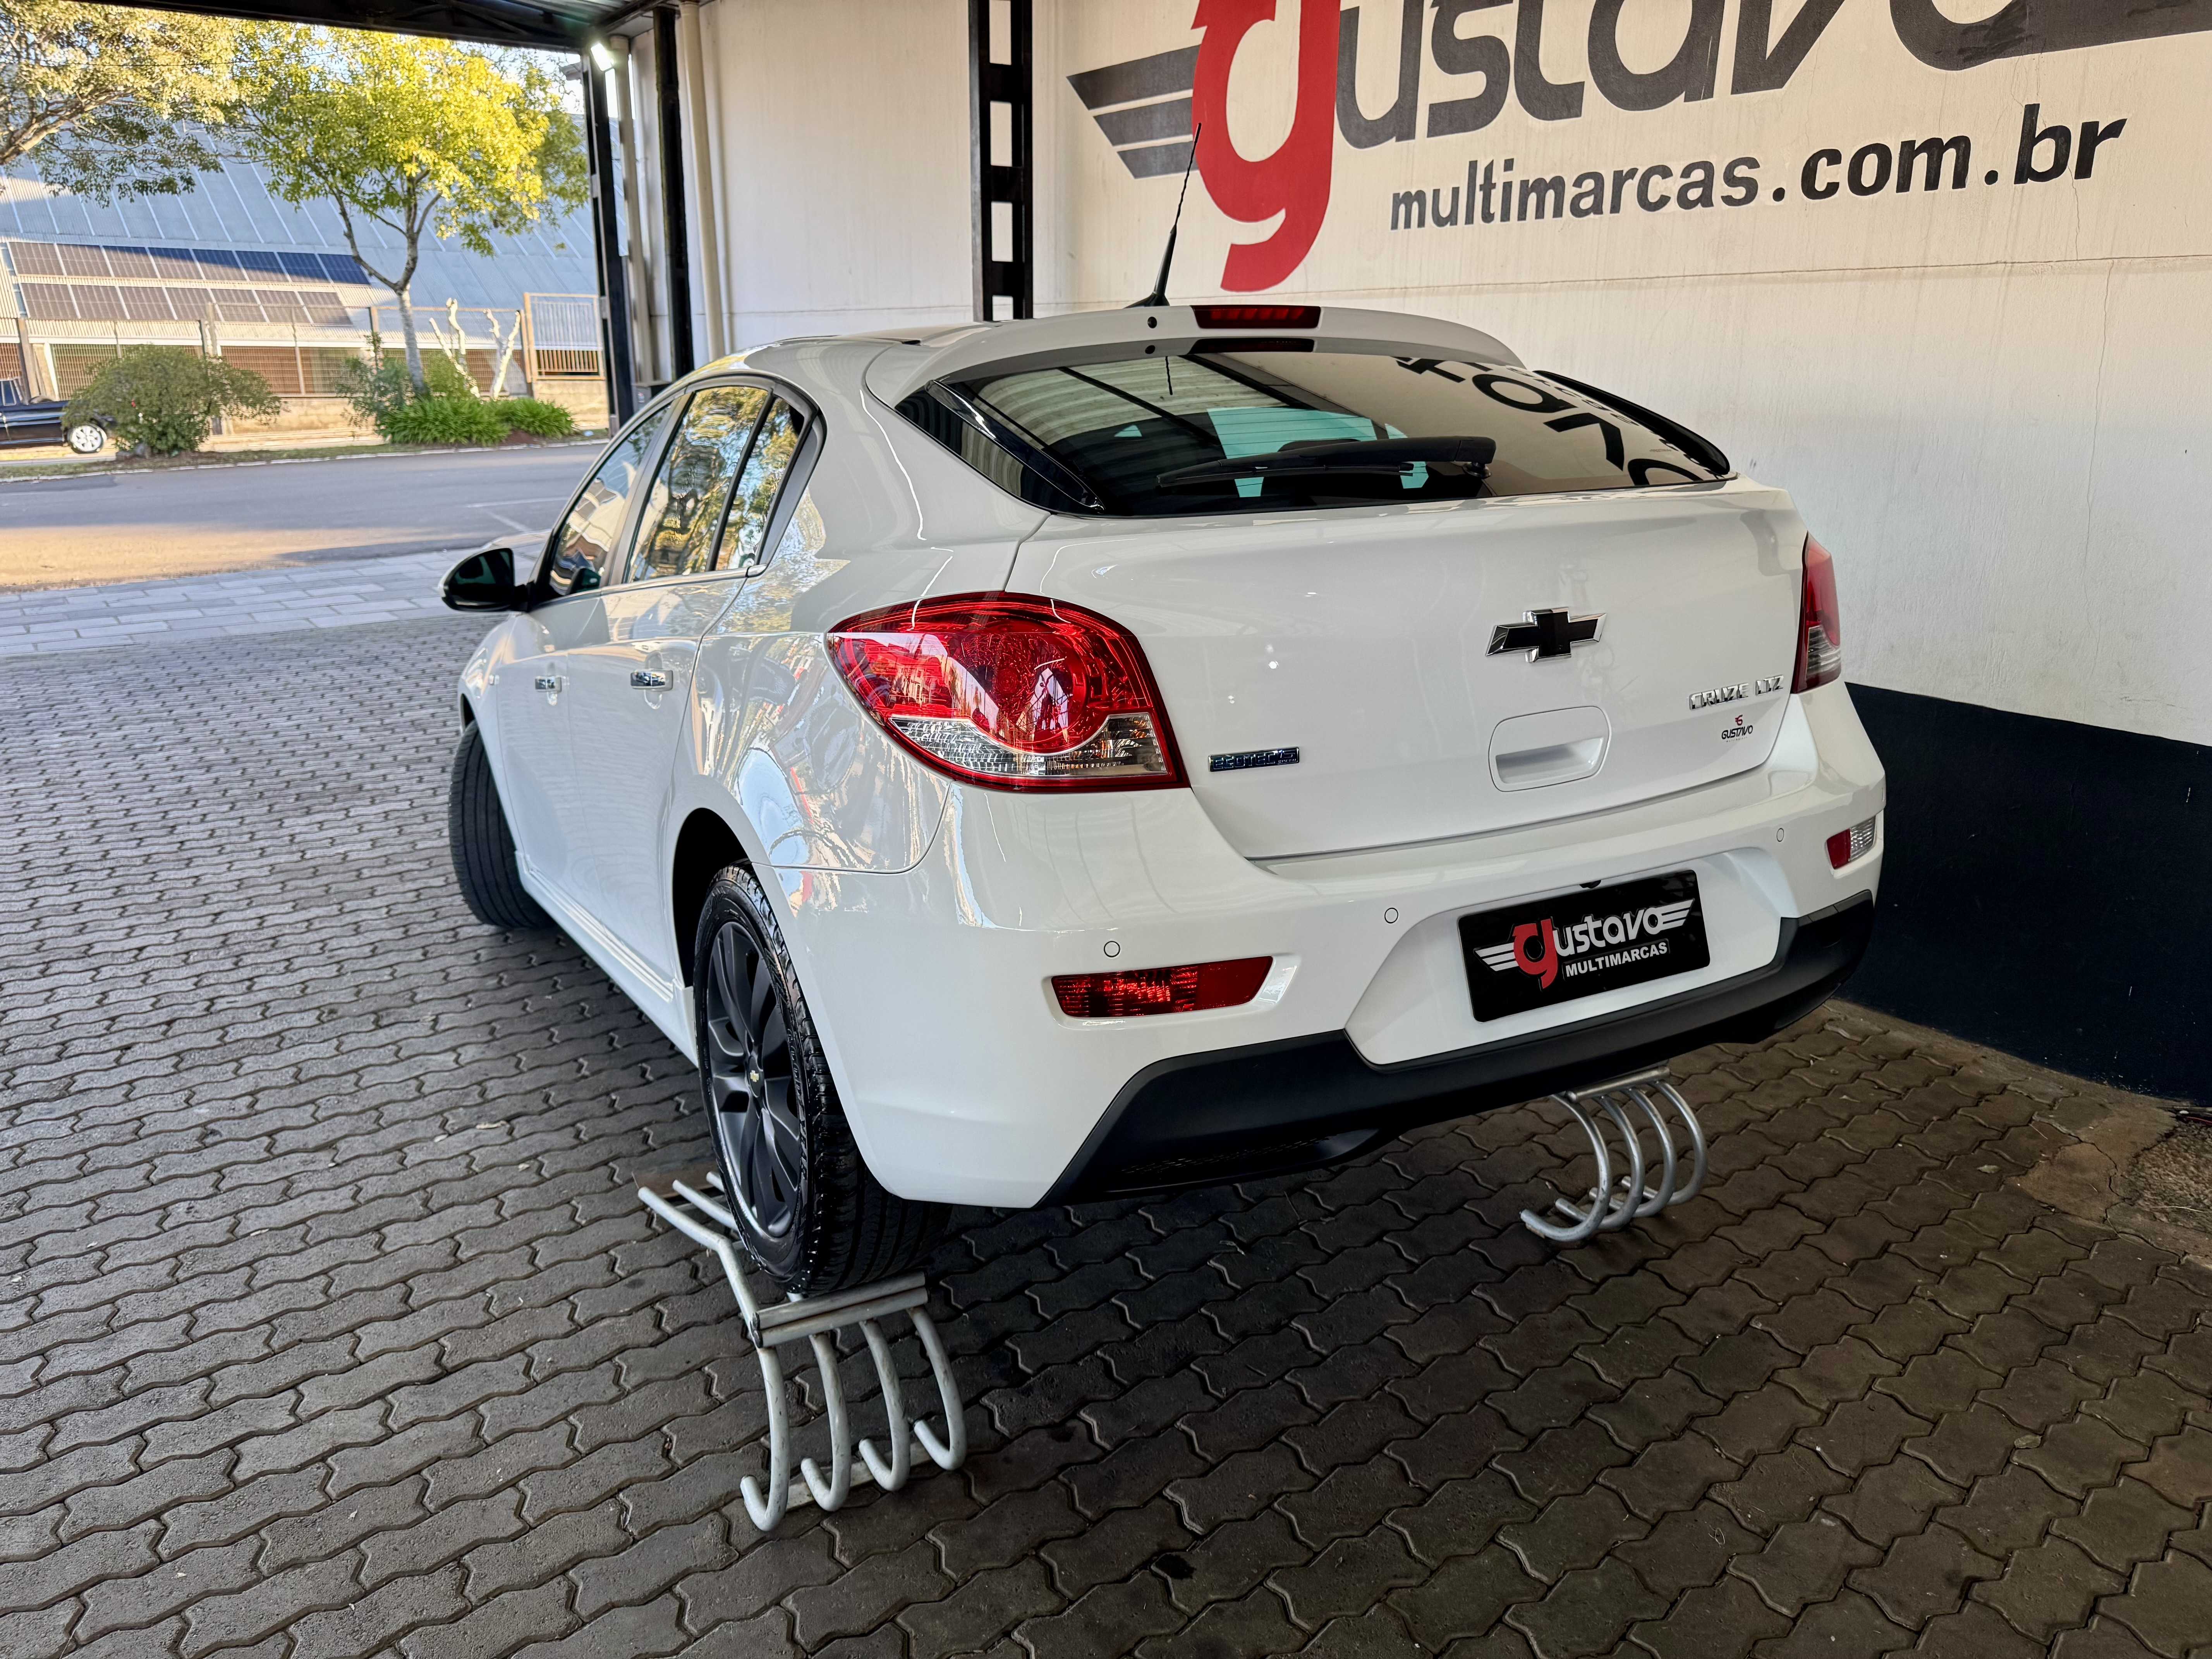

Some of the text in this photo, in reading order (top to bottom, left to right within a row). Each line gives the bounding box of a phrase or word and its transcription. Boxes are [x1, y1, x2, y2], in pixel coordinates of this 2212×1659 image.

[1689, 675, 1784, 710] CRUZE LTZ
[1721, 725, 1753, 740] GUSTAVO
[1512, 906, 1662, 989] gustavo
[1565, 942, 1668, 978] MULTIMARCAS
